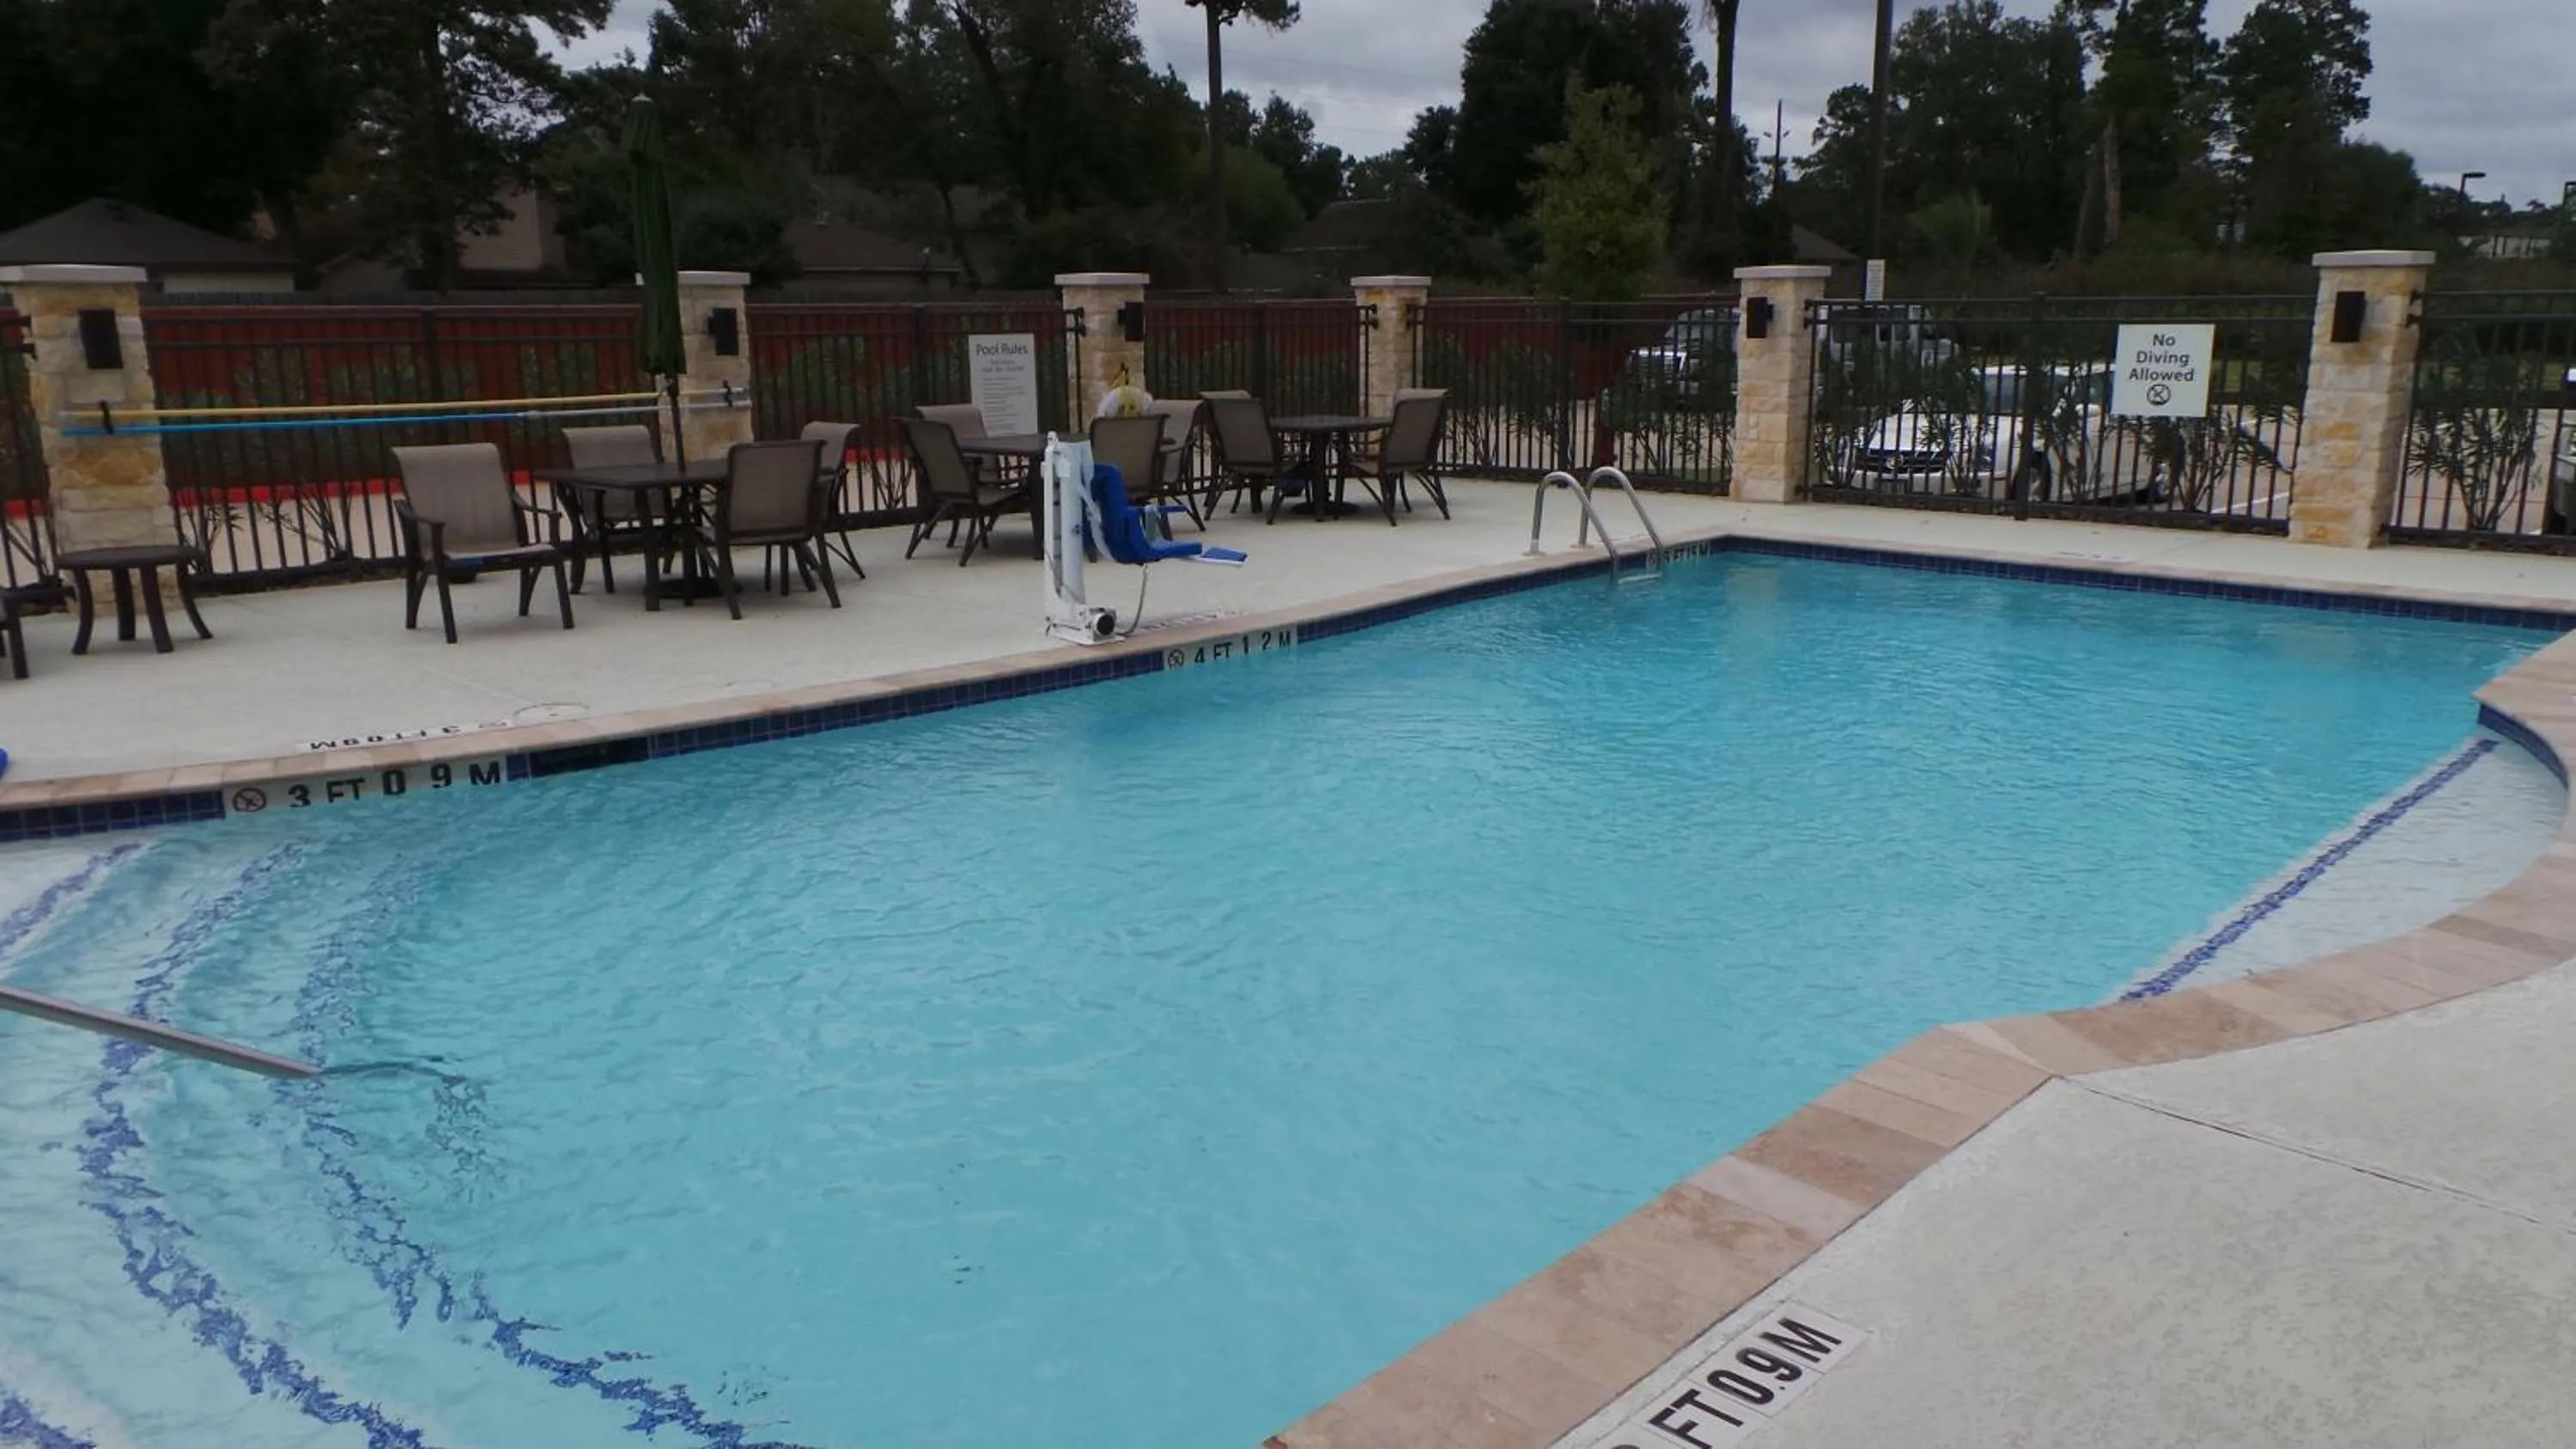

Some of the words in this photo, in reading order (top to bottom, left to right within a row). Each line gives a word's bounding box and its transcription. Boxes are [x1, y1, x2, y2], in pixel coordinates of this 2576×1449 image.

[2153, 333, 2176, 346] No
[976, 342, 999, 356] Pool
[1001, 343, 1029, 355] Rules
[2136, 350, 2190, 367] Diving
[2129, 367, 2194, 381] Allowed
[1194, 646, 1206, 663] 4
[1213, 642, 1232, 660] FT
[288, 785, 312, 808] 3
[326, 778, 365, 804] FT
[469, 761, 501, 786] M
